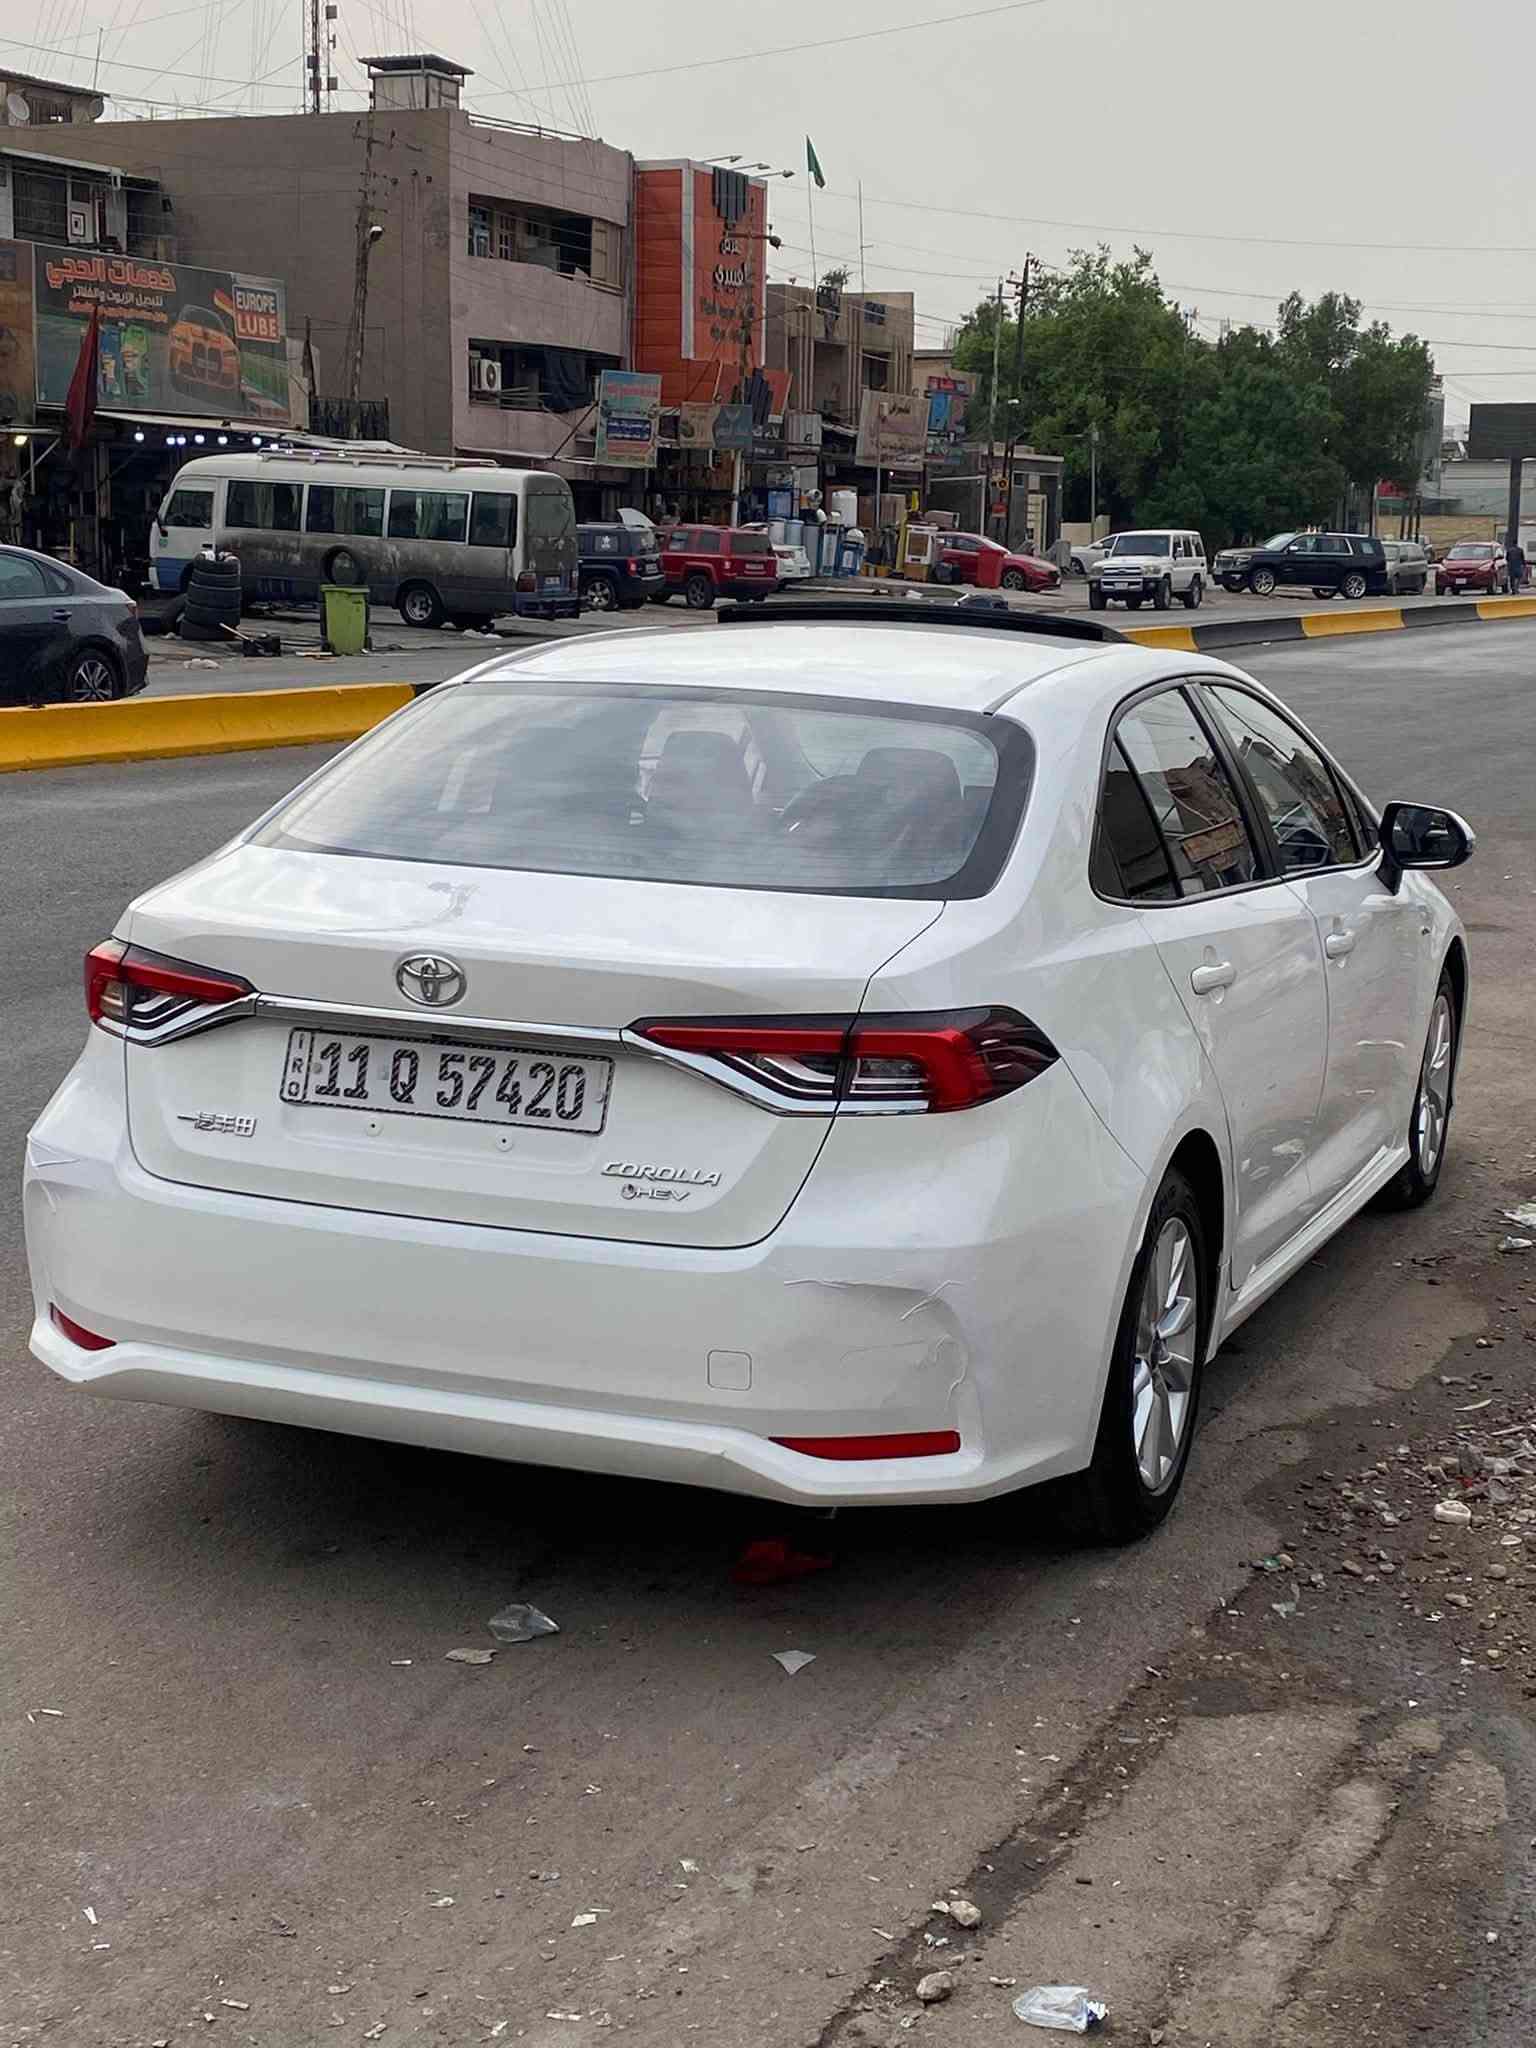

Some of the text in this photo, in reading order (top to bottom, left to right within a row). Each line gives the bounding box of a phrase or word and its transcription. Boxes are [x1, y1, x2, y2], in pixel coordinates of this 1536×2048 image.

[46, 257, 176, 292] خدمات الحجي
[236, 291, 276, 314] EUROPE
[238, 313, 277, 337] LUBE
[314, 1041, 370, 1099] 11
[389, 1048, 420, 1105] Q
[435, 1053, 586, 1121] 57420
[600, 1161, 723, 1187] COROLLA
[635, 1187, 692, 1201] HEV
